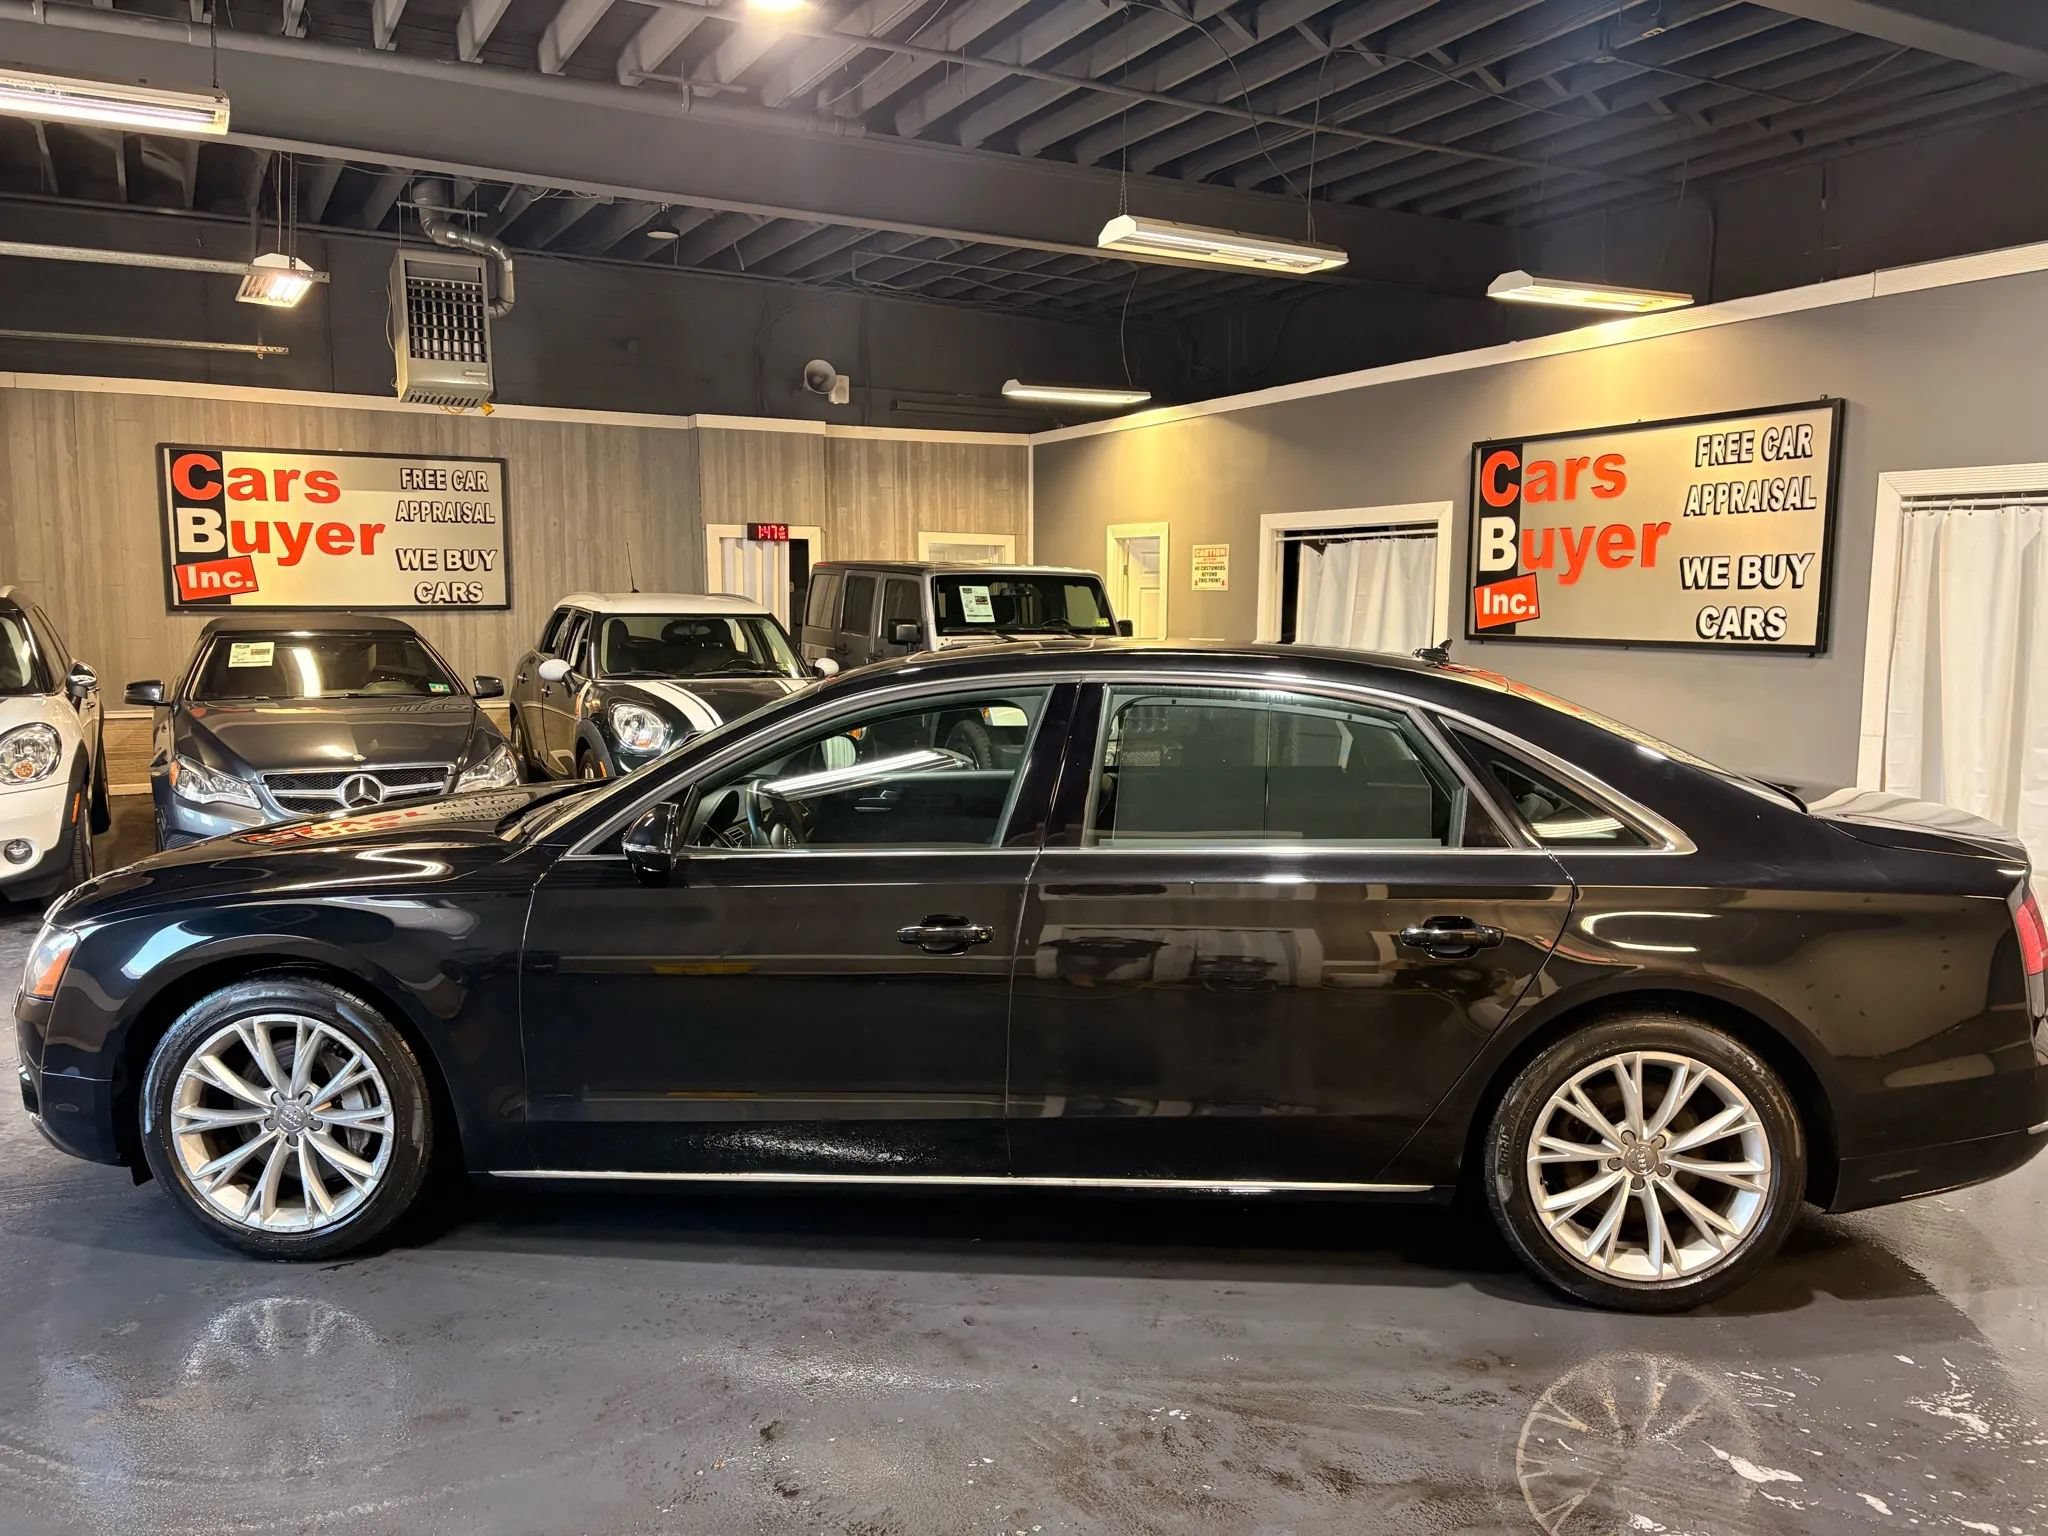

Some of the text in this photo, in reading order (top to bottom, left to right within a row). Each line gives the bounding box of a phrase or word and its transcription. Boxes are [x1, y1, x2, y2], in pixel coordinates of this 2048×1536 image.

[1695, 423, 1814, 467] FREE CAR
[171, 453, 341, 504] Cars
[400, 467, 489, 492] FREE CAR
[1481, 449, 1627, 507] Cars
[1683, 475, 1817, 517] APPRAISAL
[395, 500, 496, 524] APPRAISAL
[175, 506, 386, 566] Buyer
[1479, 515, 1672, 586] Buyer
[186, 565, 255, 590] Inc.
[396, 548, 497, 571] WE BUY
[1680, 552, 1816, 590] WE BUY
[414, 581, 484, 604] CARS
[1482, 587, 1536, 616] Inc.
[1696, 605, 1788, 641] CARS
